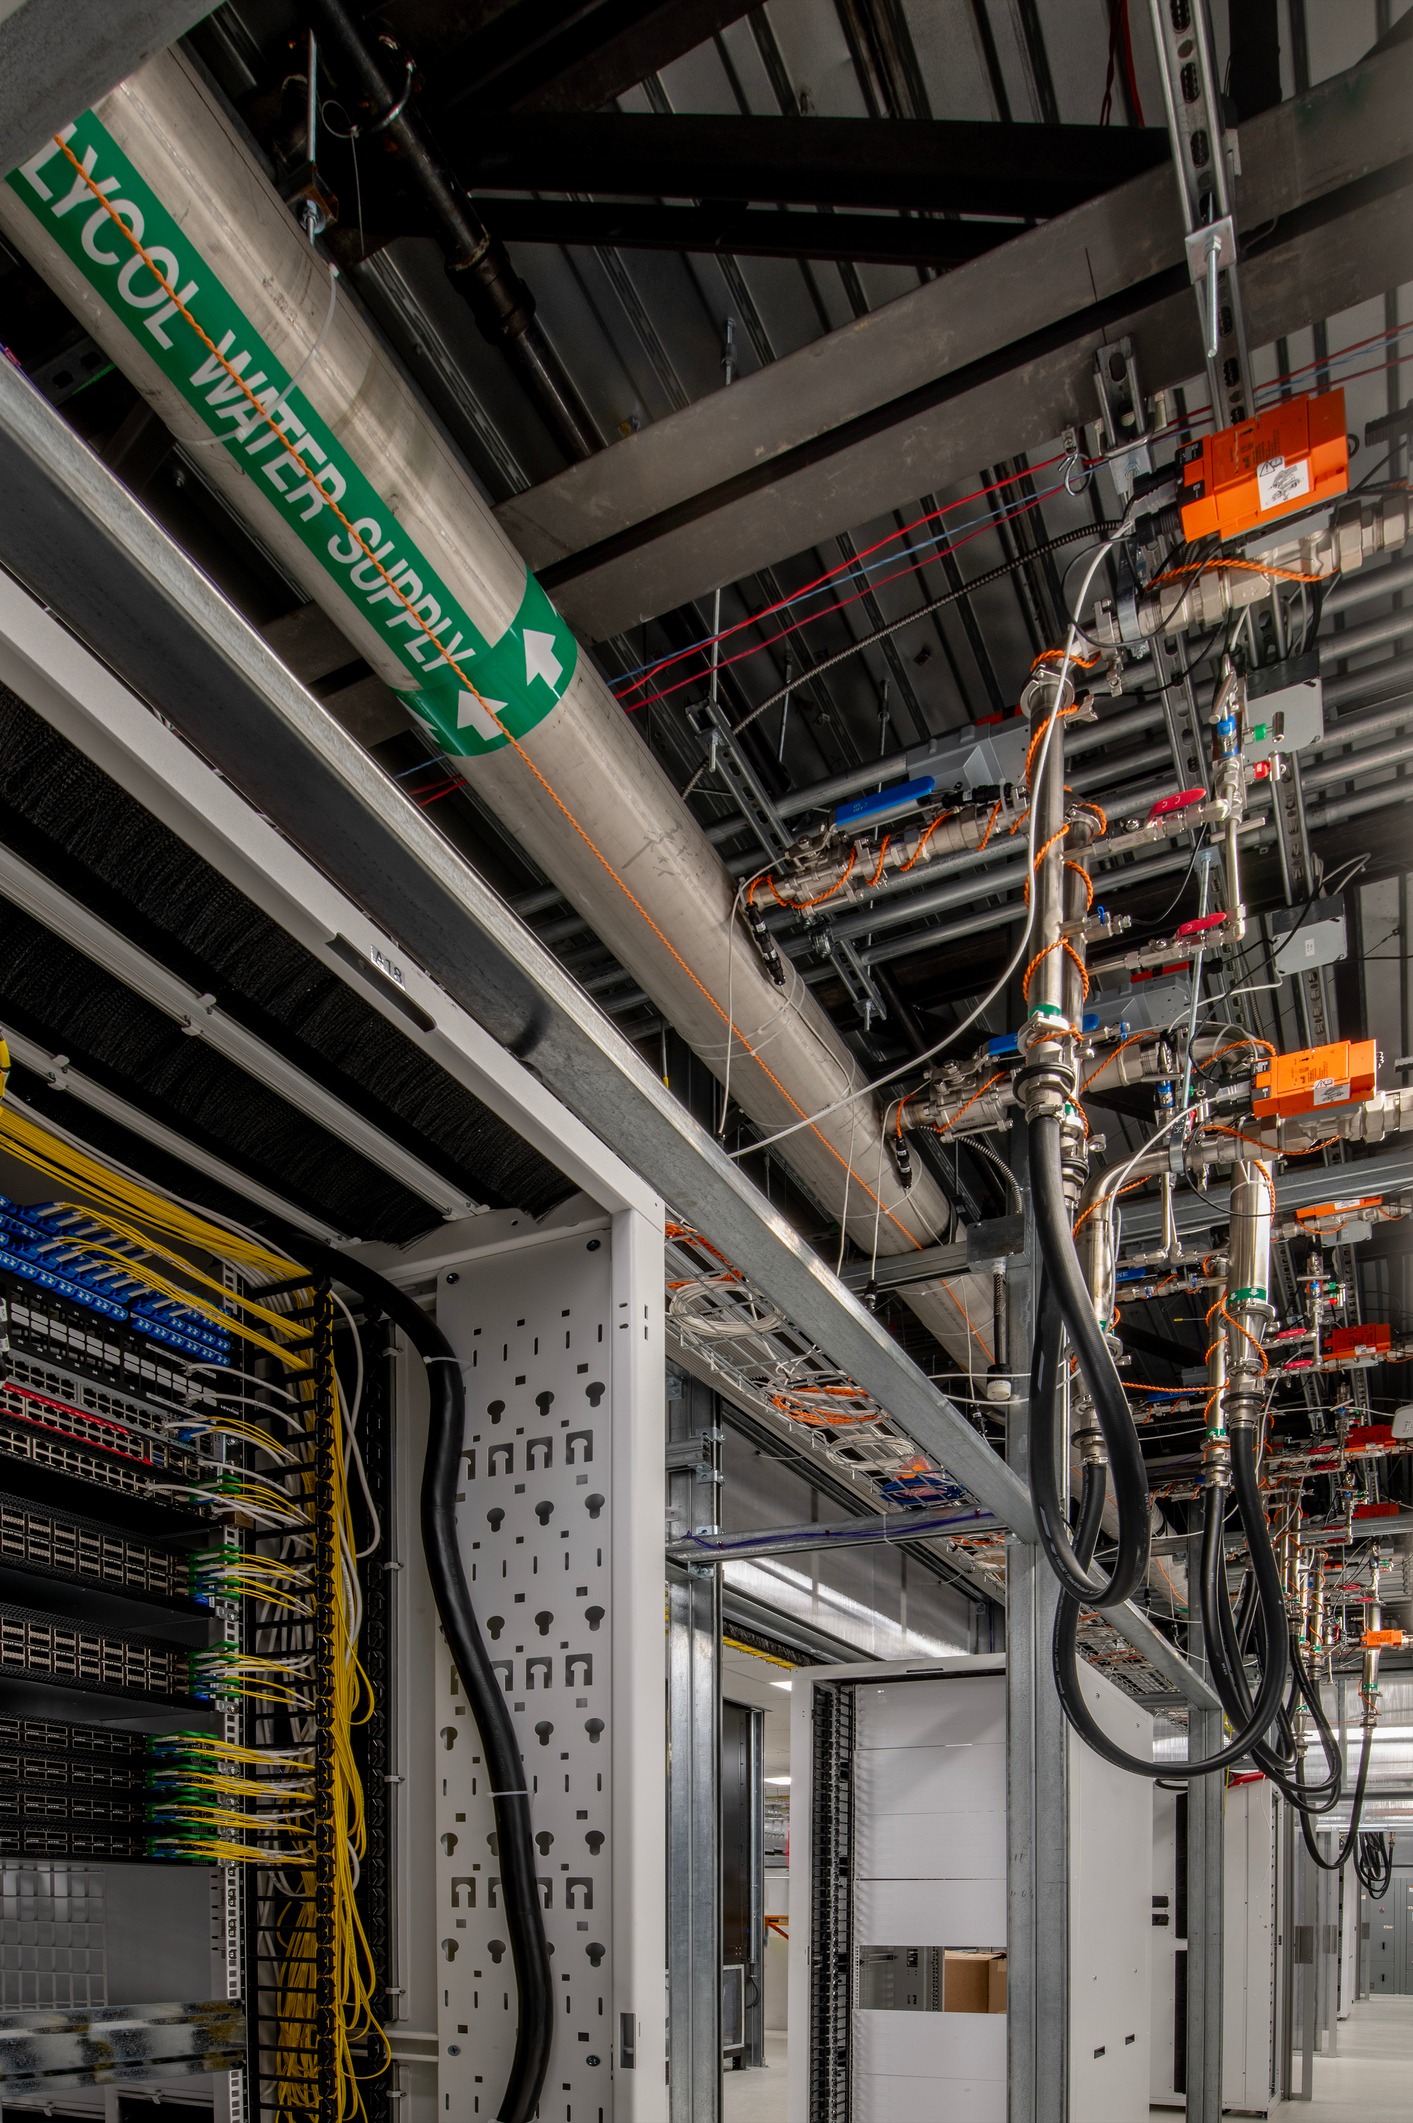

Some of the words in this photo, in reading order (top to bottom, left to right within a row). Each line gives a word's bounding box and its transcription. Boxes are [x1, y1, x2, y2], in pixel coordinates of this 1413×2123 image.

[18, 122, 200, 350] LYCOL
[189, 329, 347, 522] WATER
[328, 517, 476, 673] SUPPLY
